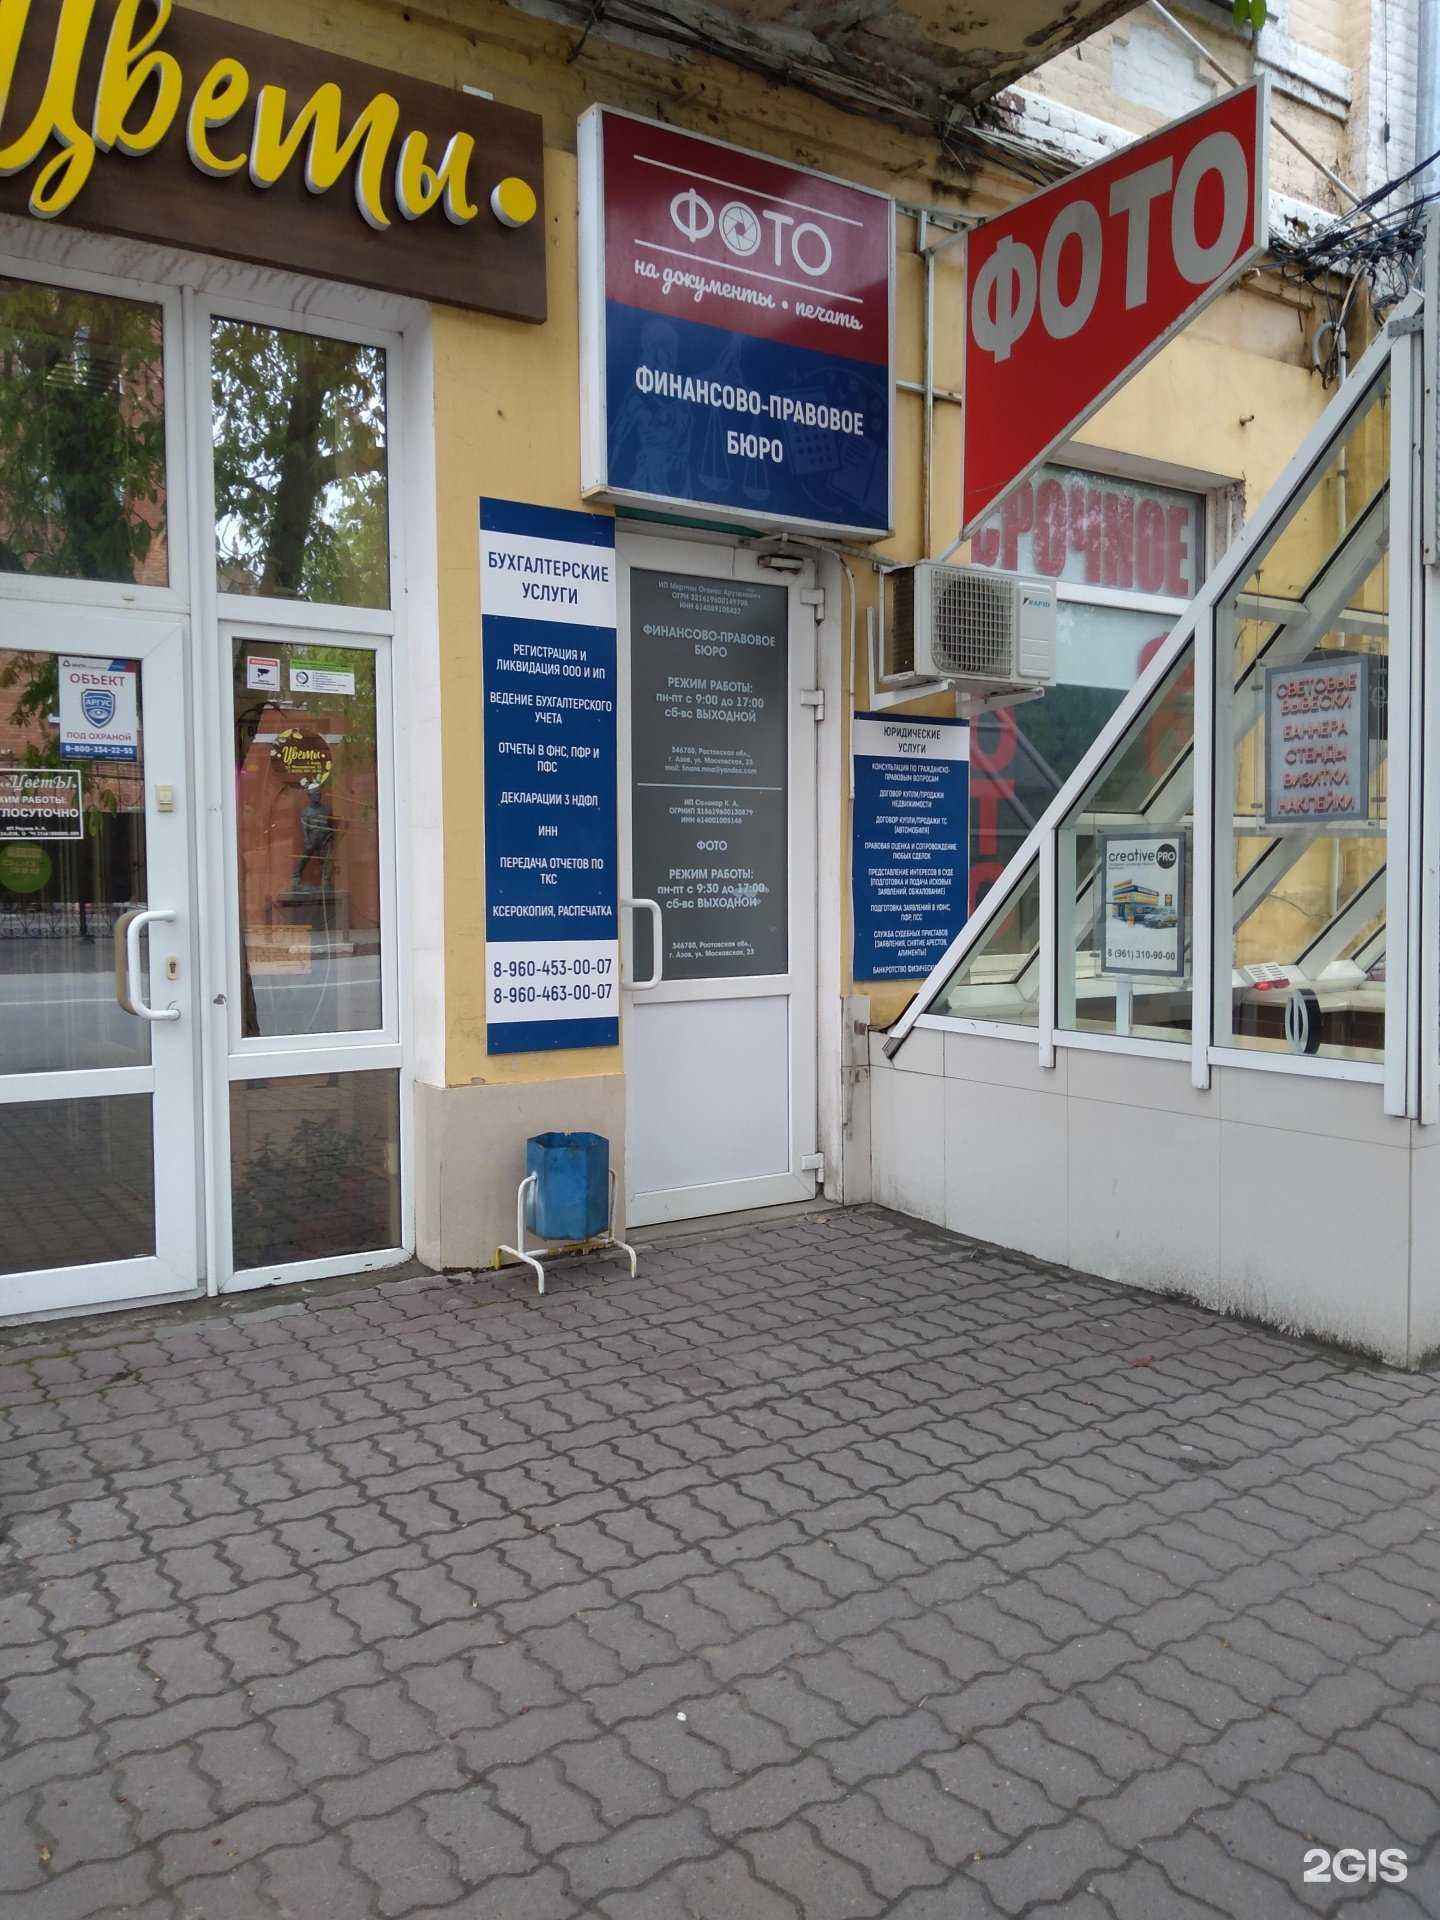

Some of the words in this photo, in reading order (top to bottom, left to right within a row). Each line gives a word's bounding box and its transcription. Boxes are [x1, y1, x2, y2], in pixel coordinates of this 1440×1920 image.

[670, 188, 832, 277] ФОТО
[971, 131, 1248, 363] ФОТО
[634, 259, 659, 278] на
[663, 268, 776, 309] документы
[795, 301, 863, 330] печать
[635, 365, 864, 437] ФИНАНСОВО-ПРАВОВОЕ
[727, 431, 783, 463] БЮРО
[488, 552, 608, 582] БУХГАЛТЕРСКИЕ
[522, 582, 578, 604] УСЛУГИ
[642, 623, 776, 647] ФИНАНСОВО-ПРАВОВОЕ
[513, 644, 577, 661] РЕГИСТРАЦИЯ
[580, 649, 587, 660] И
[695, 645, 728, 657] БЮРО
[496, 659, 560, 676] ЛИКВИДАЦИЯ
[563, 665, 582, 677] ООО
[584, 667, 590, 678] И
[592, 668, 605, 679] ИП
[70, 673, 125, 686] ОБЪЕКТ
[667, 677, 707, 690] РЕЖИМ
[710, 679, 753, 693] РАБОТЫ:
[490, 692, 533, 706] ВЕДЕНИЕ
[536, 696, 612, 712] БУХГАЛТЕРСКОГО
[656, 693, 682, 704] пн-пт
[686, 696, 692, 704] с
[695, 694, 718, 706] 9:00
[721, 698, 734, 708] до
[736, 697, 764, 709] 17:00
[535, 712, 562, 724] УЧЕТА
[665, 707, 693, 719] сб-вс
[697, 708, 757, 722] ВЫХОДНОЙ
[66, 731, 86, 740] ПОД
[88, 732, 131, 742] ОХРАНОЙ
[884, 726, 941, 740] ЮРИДИЧЕСКИЕ
[498, 742, 535, 755] ОТЧЕТЫ
[538, 744, 544, 756] В
[547, 745, 569, 759] ФНС,
[571, 747, 591, 759] ПФР
[593, 748, 600, 759] И
[898, 743, 927, 754] УСЛУГИ
[537, 760, 558, 772] ПФС
[500, 791, 562, 806] ДЕКЛАРАЦИИ
[564, 794, 570, 805] 3
[572, 794, 599, 807] НДФЛ
[0, 808, 79, 818] ЛОСУТОЧНО
[538, 825, 558, 837] ИНН
[696, 840, 728, 851] ФОТО
[1108, 849, 1154, 862] creative
[1158, 852, 1176, 861] PRO
[500, 856, 548, 870] ПЕРЕДАЧА
[550, 857, 589, 870] ОТЧЕТОВ
[591, 859, 604, 870] ПО
[540, 873, 558, 885] ТКС
[669, 869, 708, 880] РЕЖИМ
[711, 868, 754, 880] РАБОТЫ:
[657, 886, 684, 895] пн-пт
[687, 886, 694, 894] с
[696, 883, 719, 893] 9:30
[721, 886, 735, 895] до
[666, 899, 694, 909] сб-вс
[697, 897, 758, 909] ВЫХОДНОЙ
[492, 905, 556, 919] КСЕРОКОПИЯ,
[558, 905, 612, 917] РАСПЕЧАТКА
[1135, 950, 1176, 960] 310-90-00
[493, 958, 612, 978] 8-960-453-00-07
[494, 983, 612, 1004] 8-960-463-00-07
